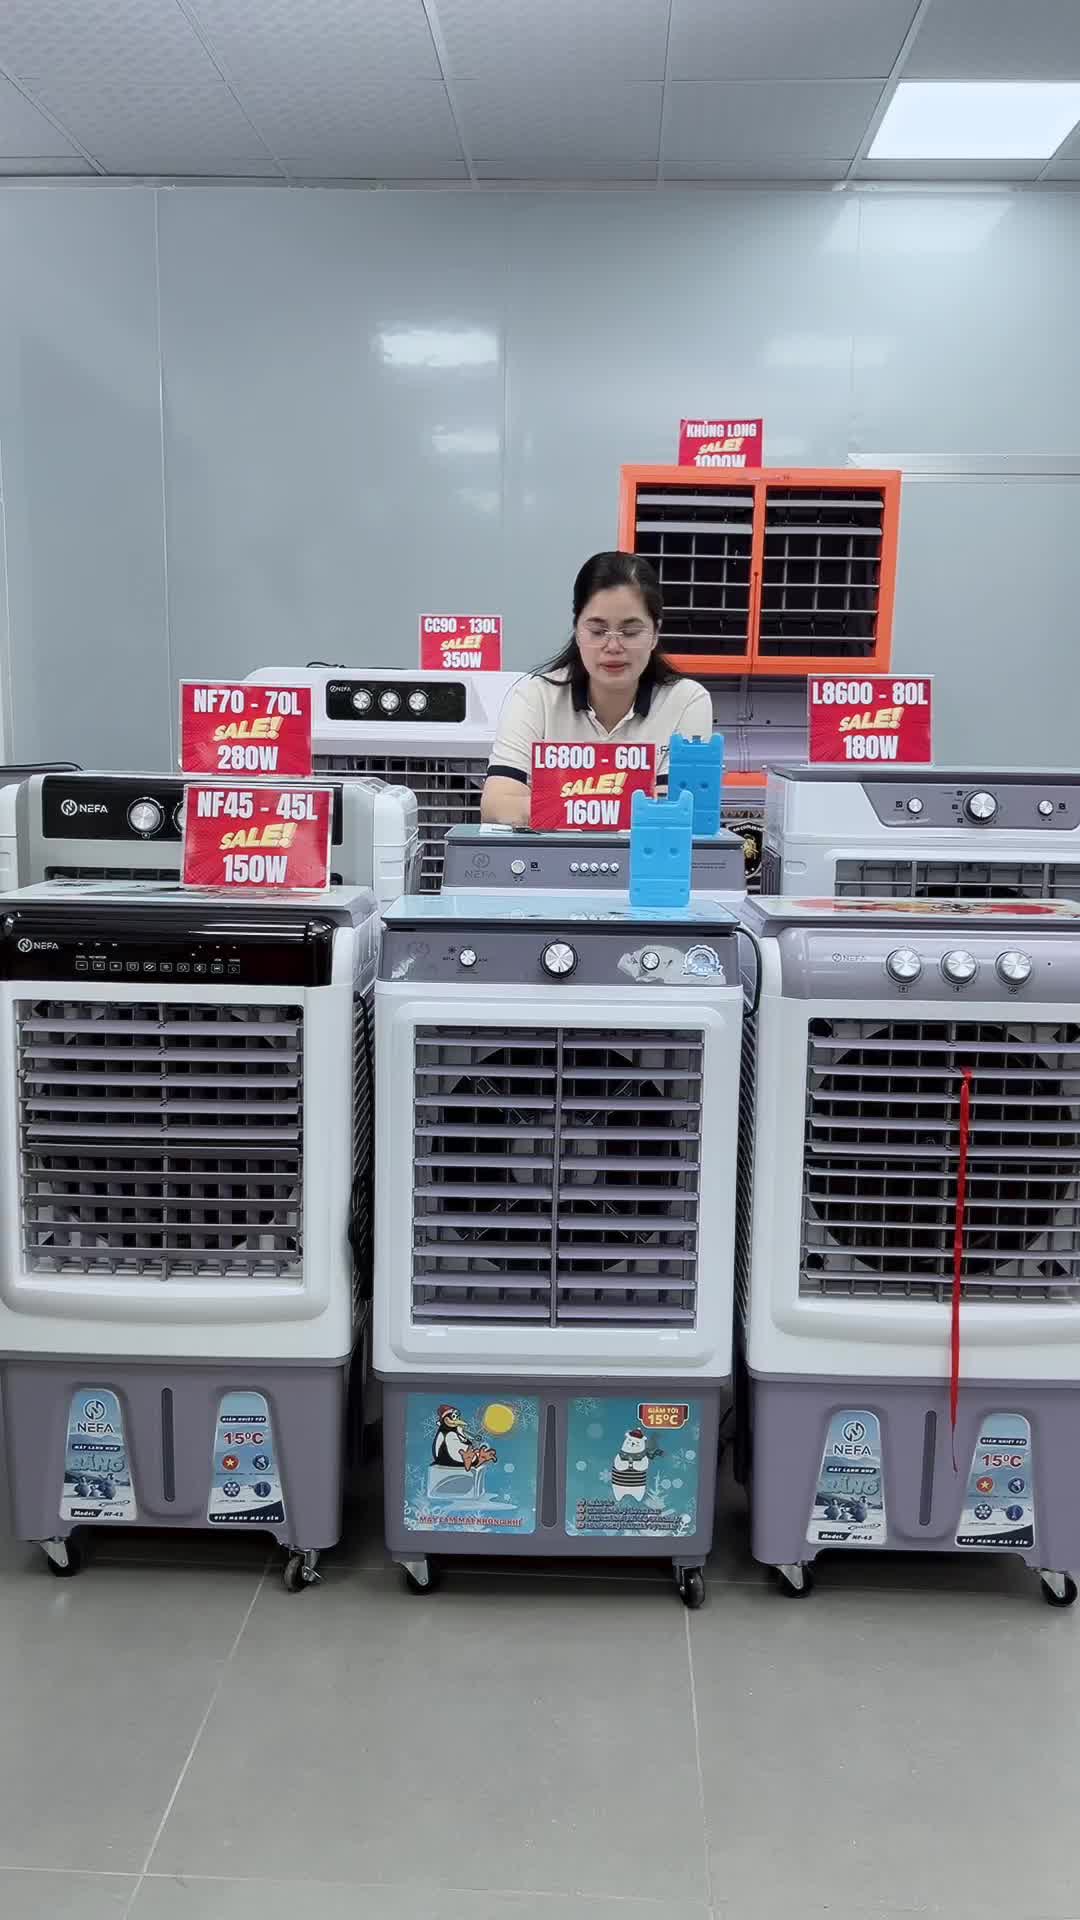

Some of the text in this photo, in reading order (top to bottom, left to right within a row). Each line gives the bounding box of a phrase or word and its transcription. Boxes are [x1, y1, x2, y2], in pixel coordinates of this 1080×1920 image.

[687, 421, 757, 438] KHỦNG LONG
[698, 438, 744, 454] SALE!
[694, 454, 746, 467] 1000W
[424, 618, 457, 633] CC90
[469, 618, 498, 634] 130L
[440, 635, 484, 651] SALE!
[443, 652, 482, 668] 350W
[194, 689, 244, 714] NF70
[265, 691, 302, 715] 70L
[813, 681, 873, 705] L8600
[892, 682, 928, 705] 80L
[213, 716, 284, 741] SALE!
[838, 706, 904, 732] SALE!
[217, 745, 278, 770] 280W
[535, 745, 595, 770] L6800
[615, 746, 650, 770] 60L
[843, 735, 899, 759] 180W
[560, 771, 629, 798] SALE!
[79, 804, 109, 813] NEFA
[197, 791, 253, 818] NF45
[276, 793, 318, 820] 45L
[563, 800, 621, 825] 160W
[219, 822, 297, 850] SALE!
[223, 855, 288, 883] 150W
[33, 942, 59, 950] NEFA
[77, 1422, 114, 1433] NEFA
[834, 1444, 871, 1456] NEFA
